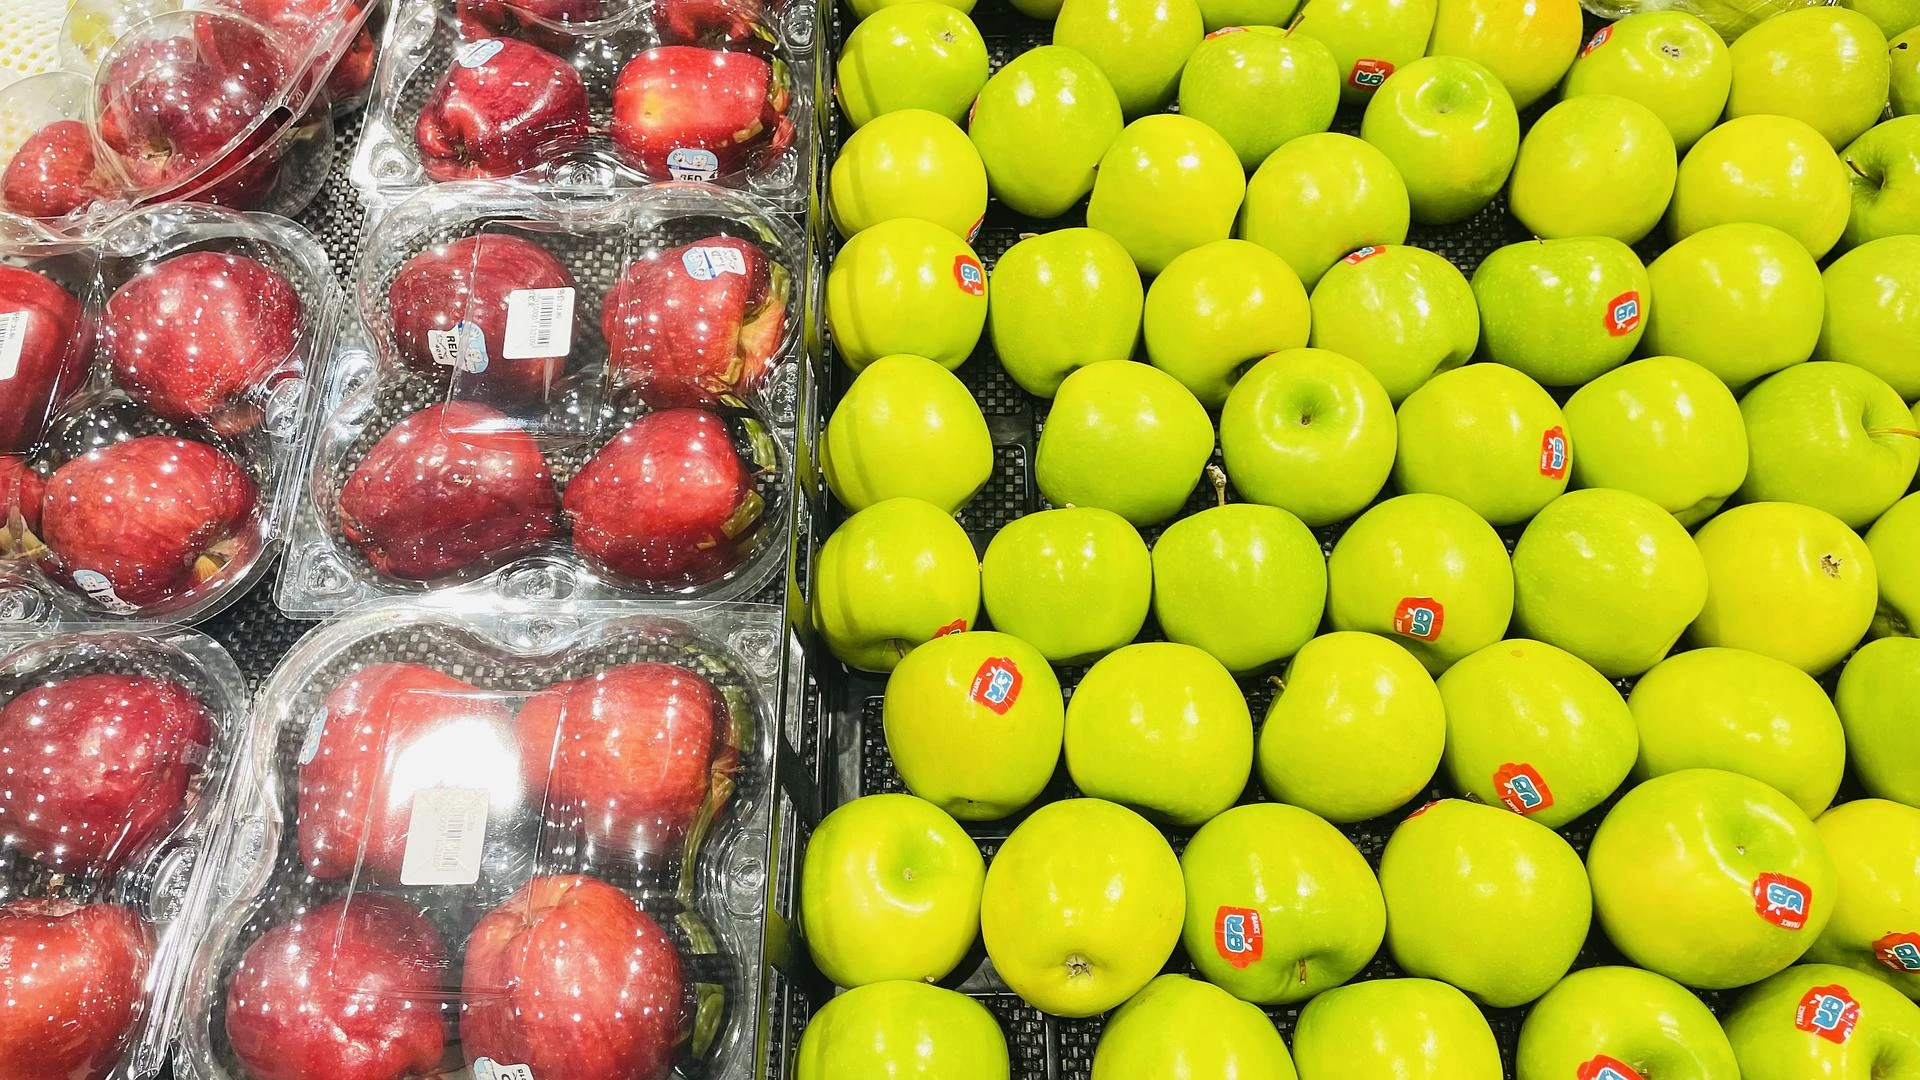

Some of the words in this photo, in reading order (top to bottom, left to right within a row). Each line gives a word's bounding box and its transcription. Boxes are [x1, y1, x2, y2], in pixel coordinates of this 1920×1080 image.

[446, 335, 458, 359] RED
[971, 676, 983, 697] FRANCE
[1250, 912, 1261, 935] FRANCE
[1781, 918, 1801, 929] FRANCE
[1796, 1005, 1806, 1026] FRANCE
